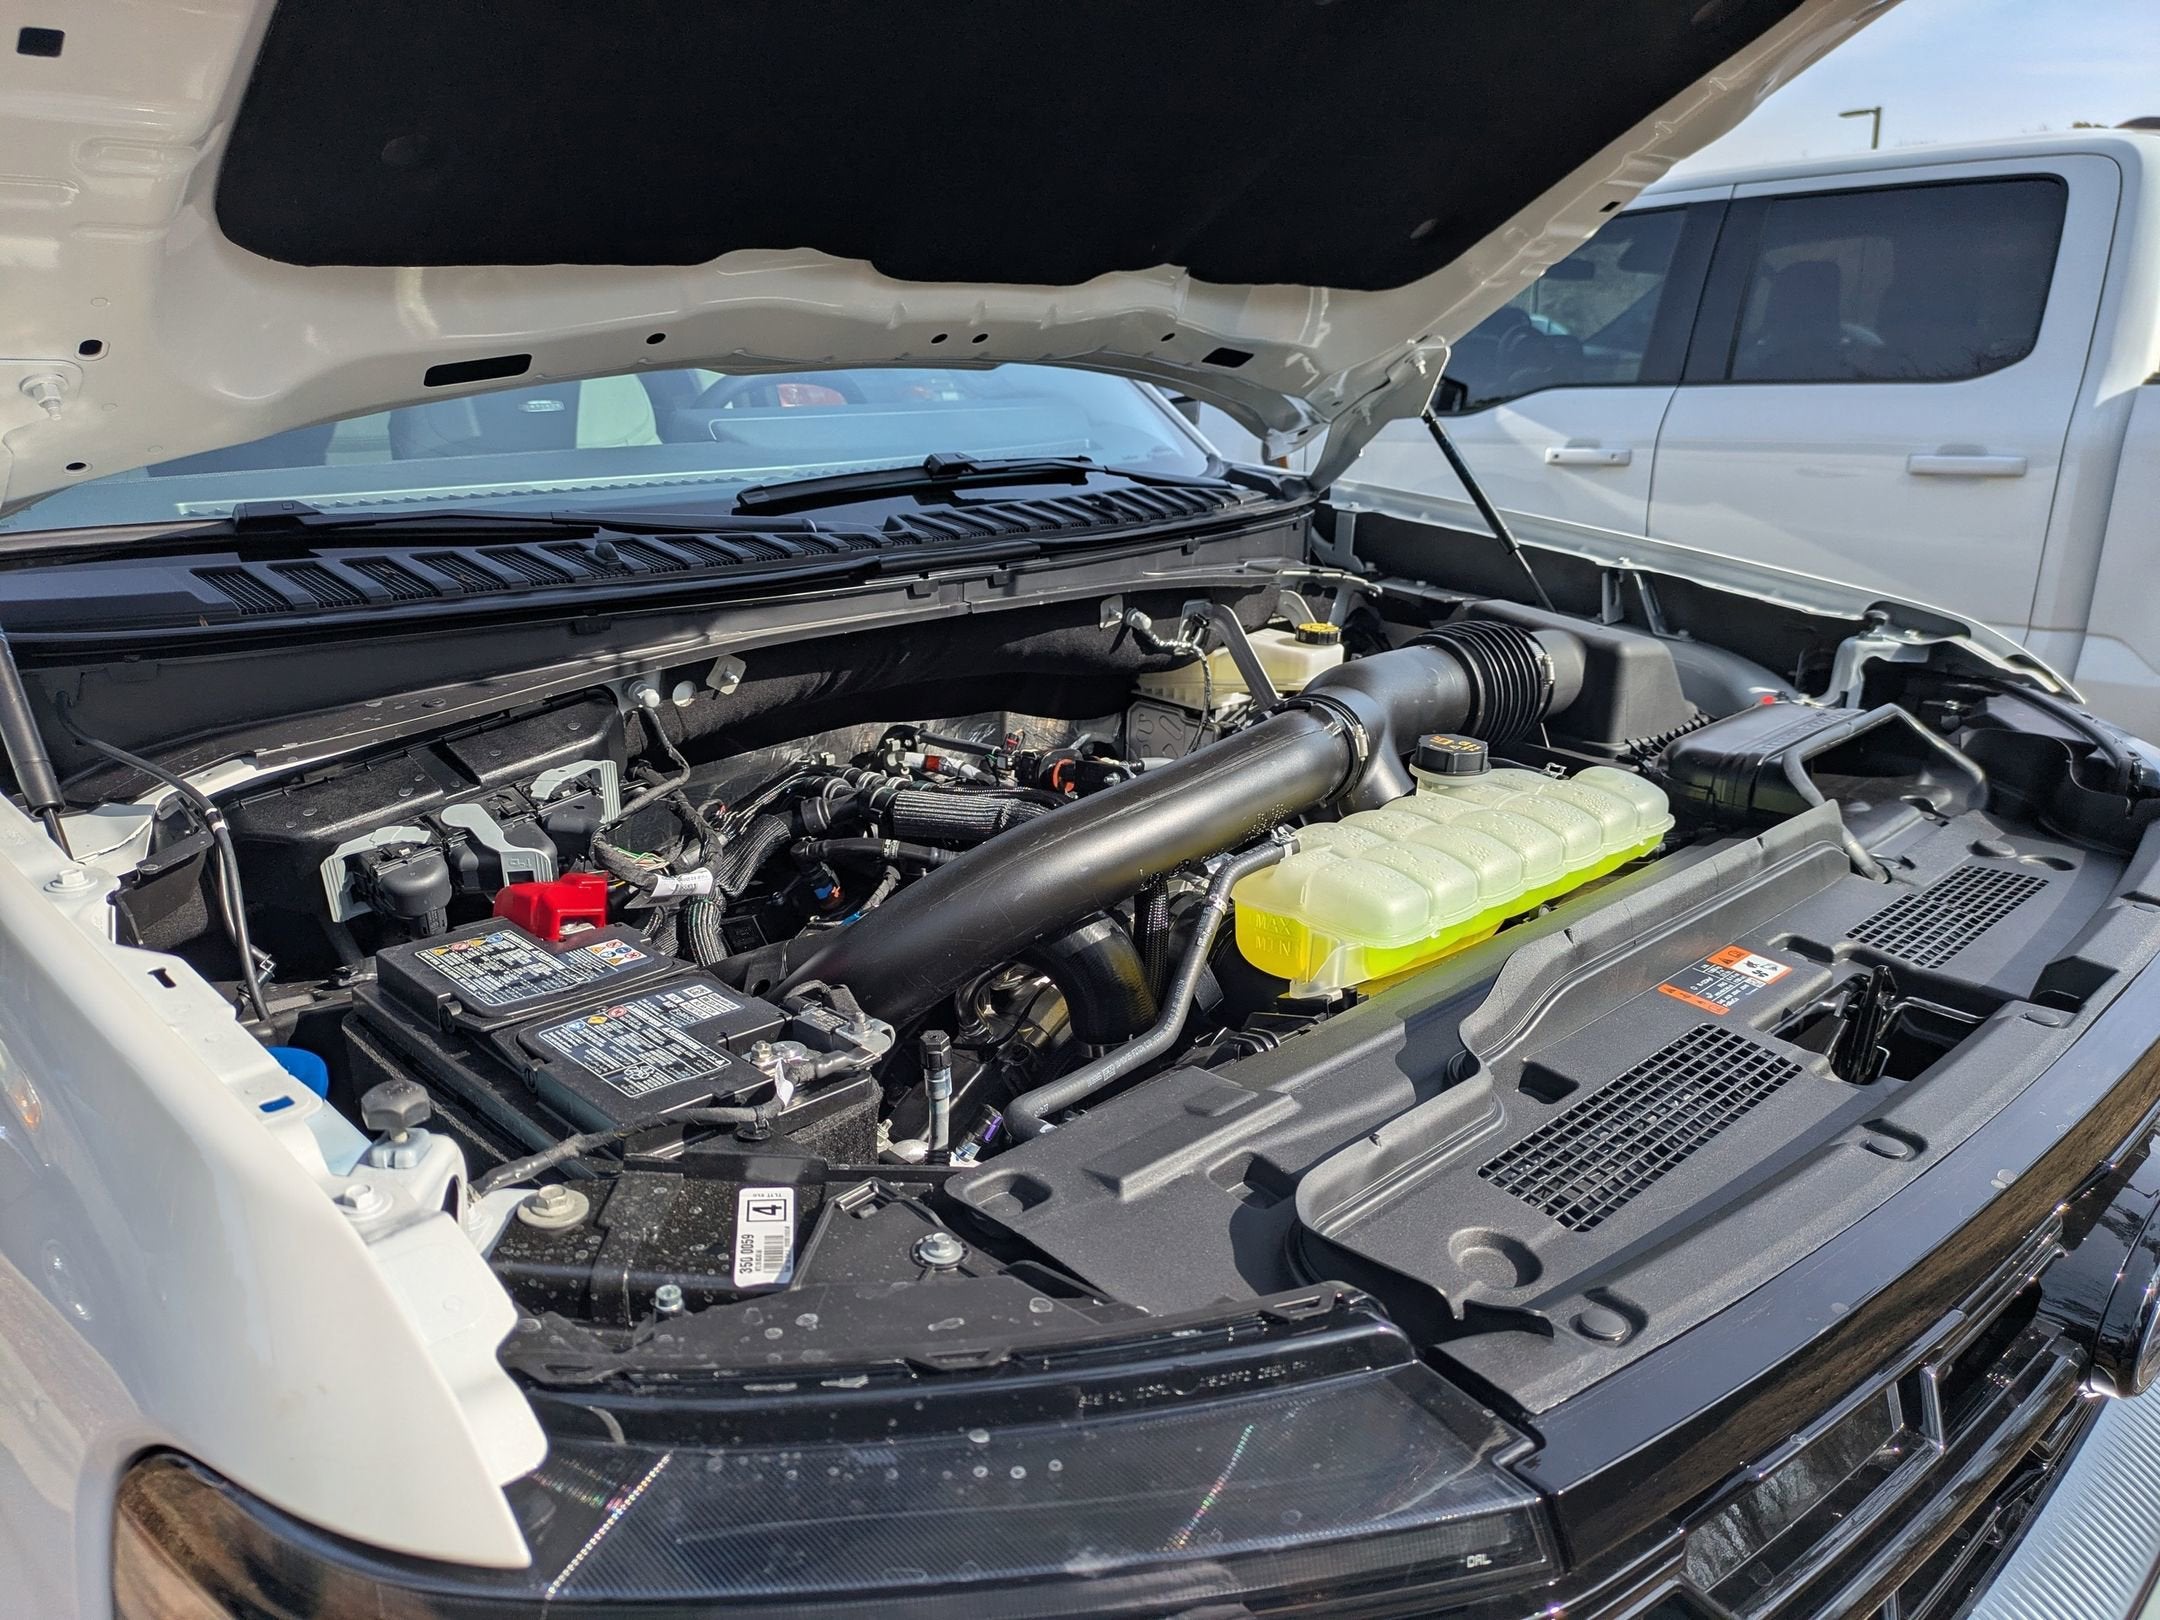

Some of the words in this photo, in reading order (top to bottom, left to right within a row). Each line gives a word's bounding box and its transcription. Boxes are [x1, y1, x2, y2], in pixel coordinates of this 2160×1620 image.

[1255, 912, 1291, 936] MAX
[1255, 935, 1291, 957] MIN
[752, 1205, 782, 1215] 4
[740, 1233, 754, 1255] 0059
[739, 1256, 754, 1274] 350
